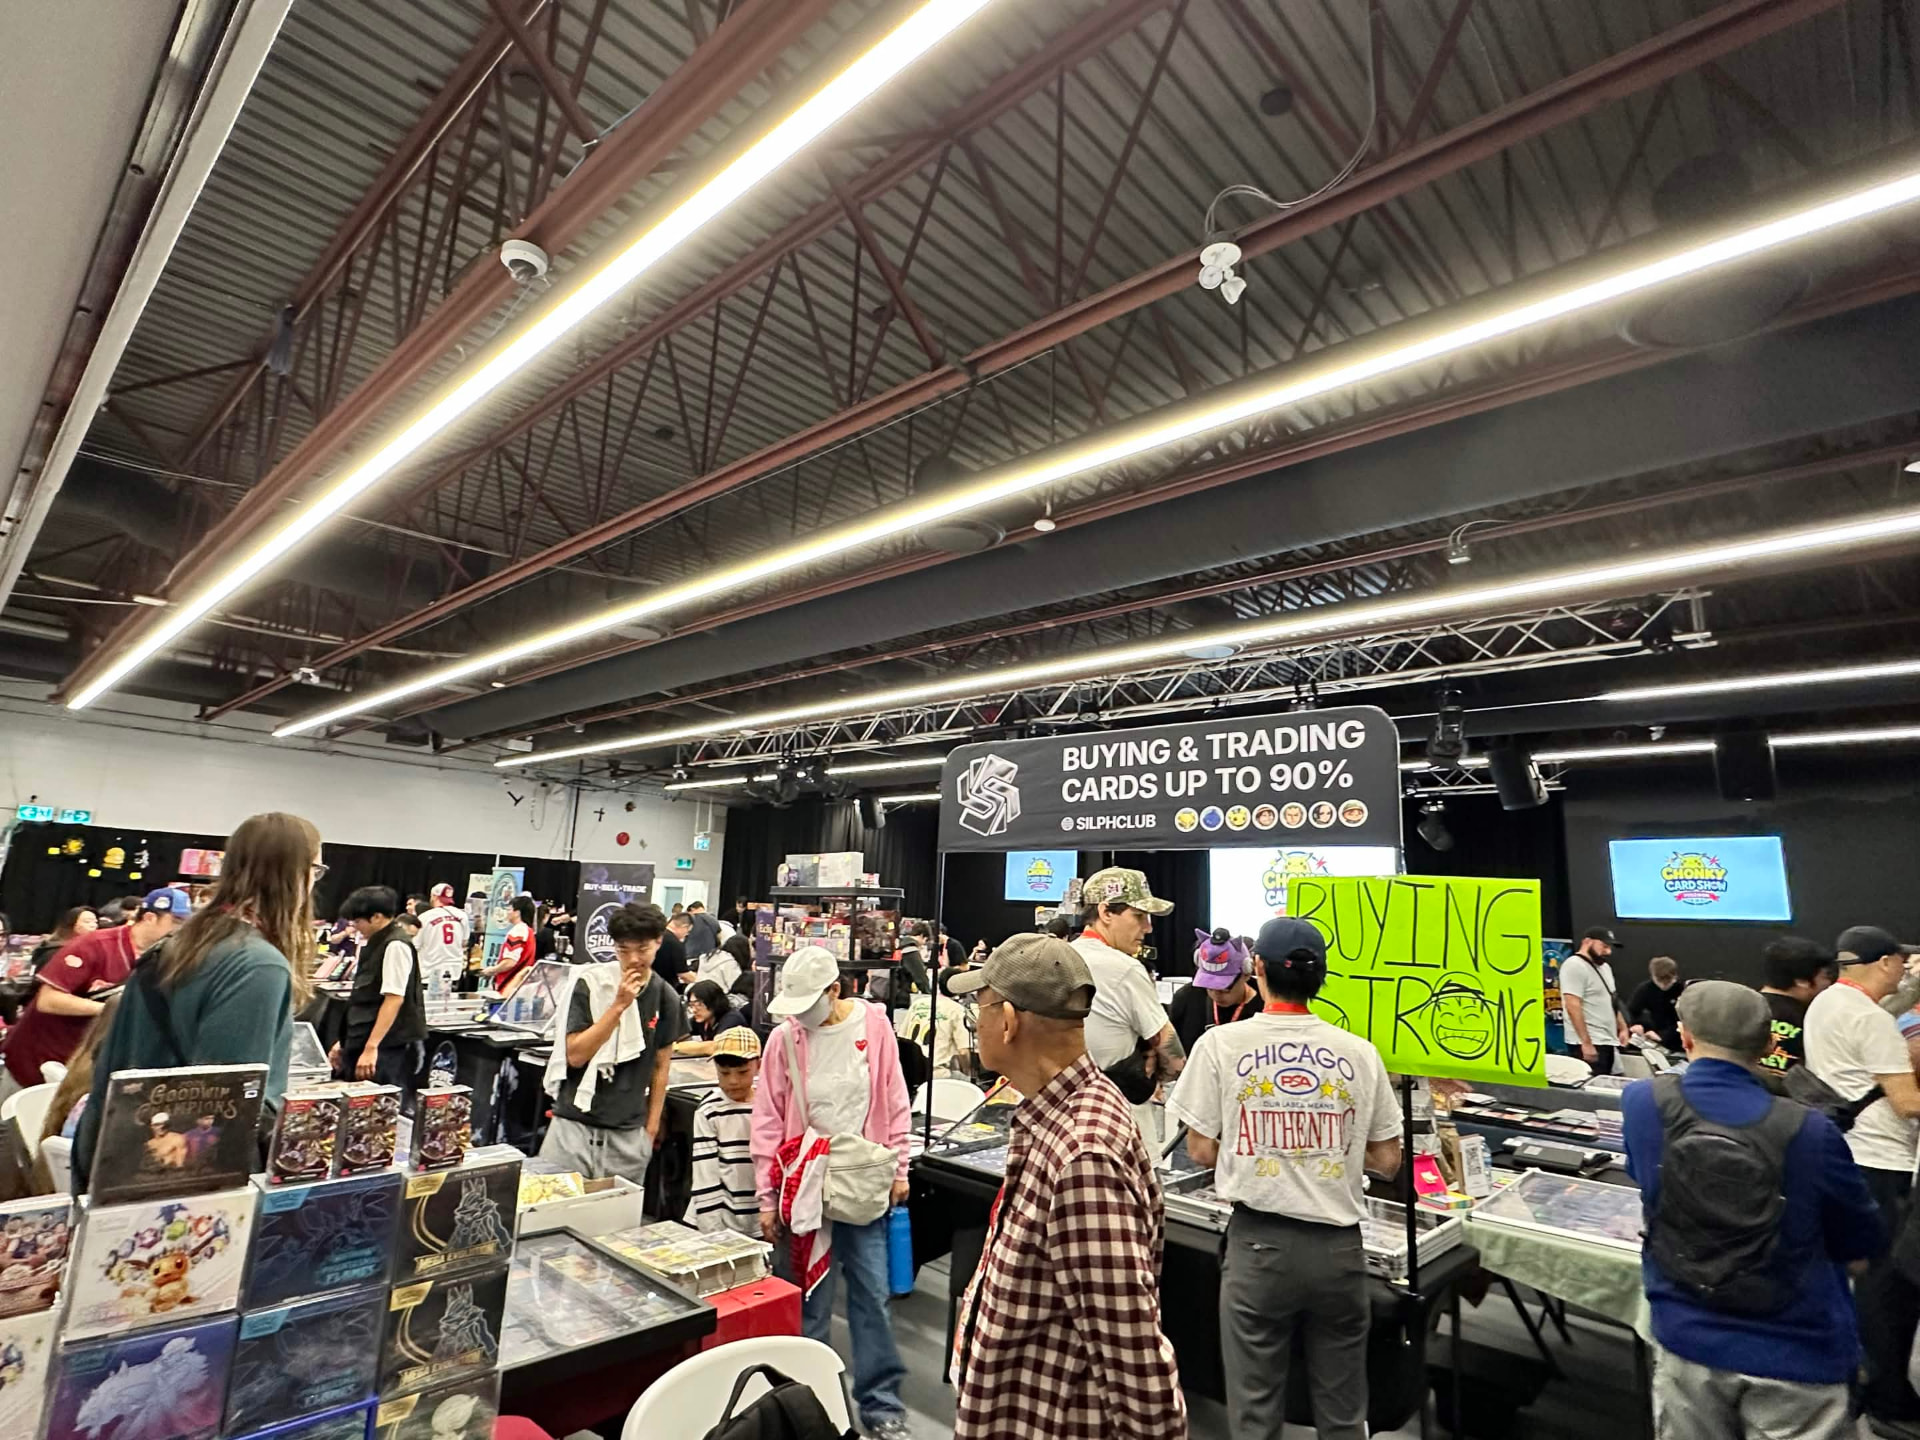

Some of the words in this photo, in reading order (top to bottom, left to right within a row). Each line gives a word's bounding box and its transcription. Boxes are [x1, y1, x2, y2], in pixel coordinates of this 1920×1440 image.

[1062, 738, 1171, 771] BUYING
[1177, 736, 1199, 762] &
[1205, 720, 1366, 760] TRADING
[1061, 774, 1158, 802] CARDS
[1165, 770, 1208, 797] UP
[1215, 766, 1262, 794] TO
[1269, 759, 1354, 791] 90%
[1661, 867, 1728, 880] CHONKY
[1665, 880, 1697, 891] CARD
[1696, 880, 1727, 891] SHOW
[443, 923, 454, 944] 6
[1297, 879, 1534, 975] BUYING
[1237, 1042, 1354, 1081] CHICAGO
[1281, 1074, 1312, 1088] PSA
[1236, 1103, 1356, 1156] AUTHENTIC
[1255, 1157, 1280, 1177] 20
